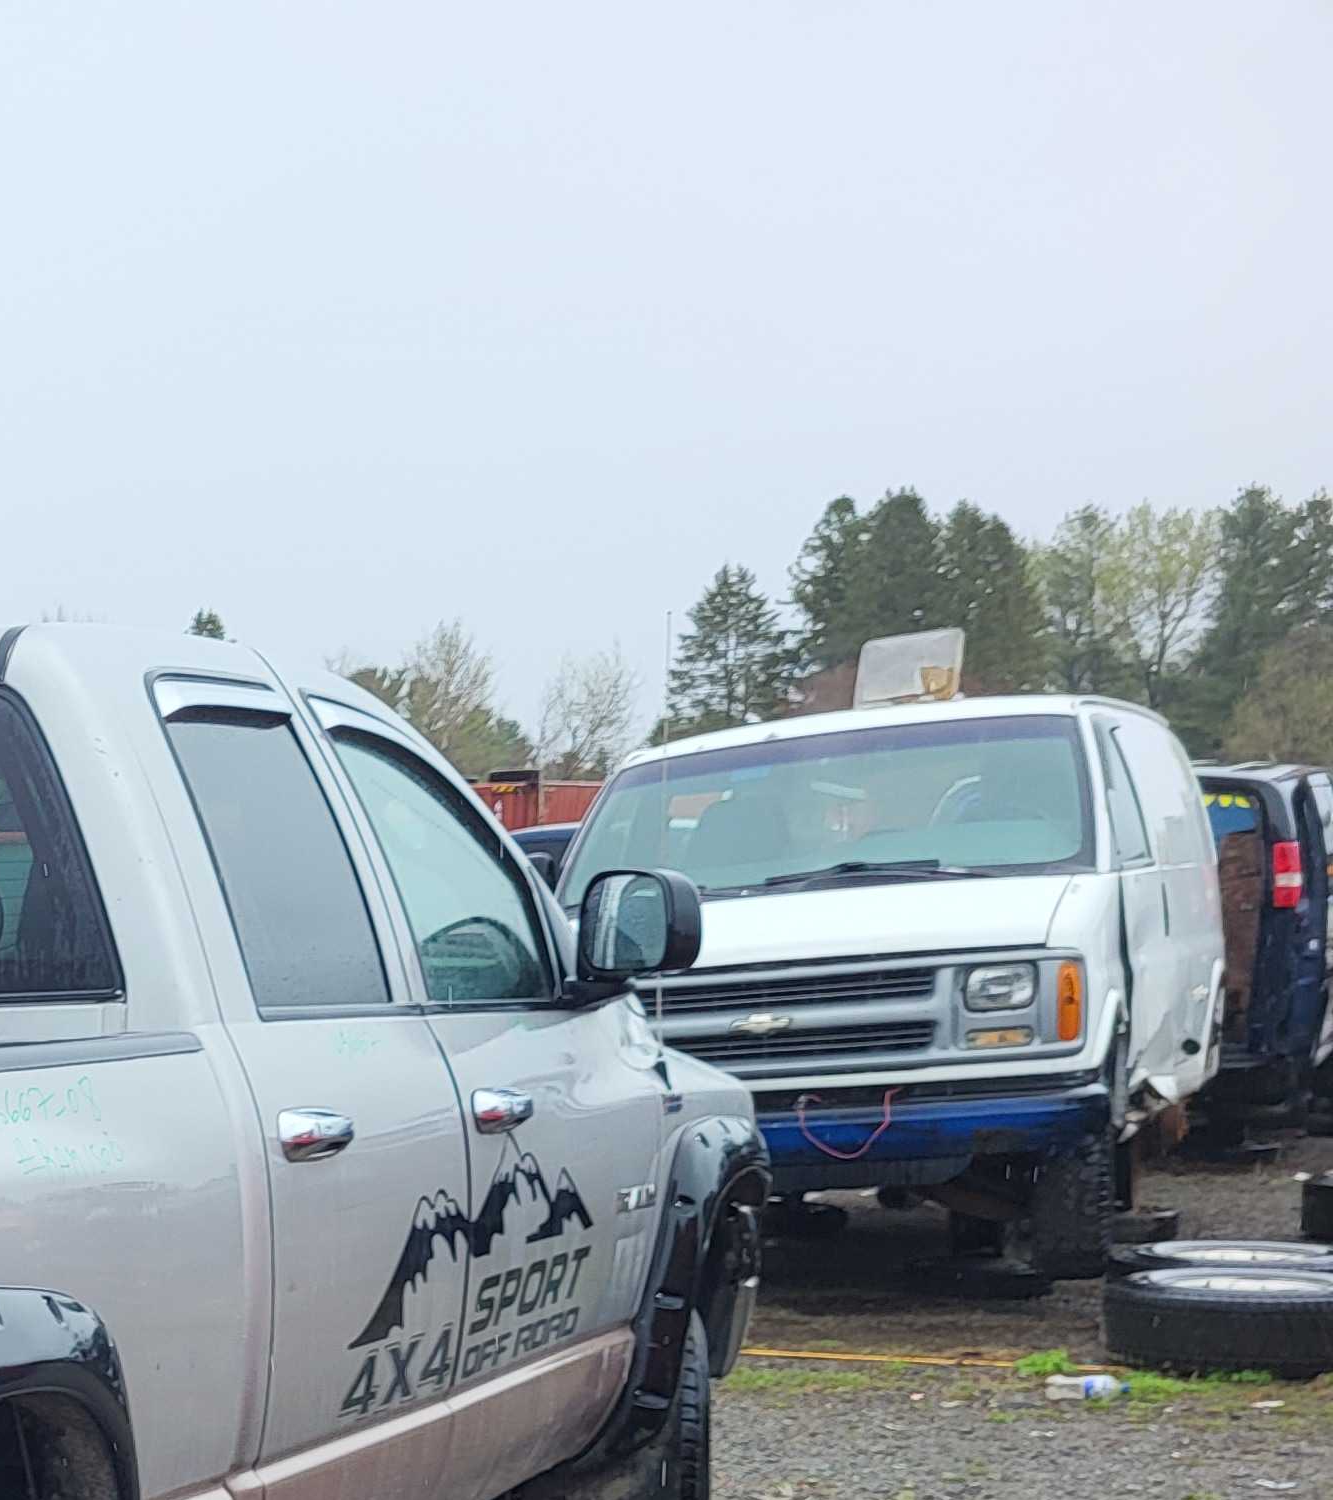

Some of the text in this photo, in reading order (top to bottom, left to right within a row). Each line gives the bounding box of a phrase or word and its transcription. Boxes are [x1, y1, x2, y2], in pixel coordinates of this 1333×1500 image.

[468, 1245, 592, 1336] SPORT
[337, 1322, 455, 1421] 4X4
[460, 1306, 581, 1379] OFF ROAD
